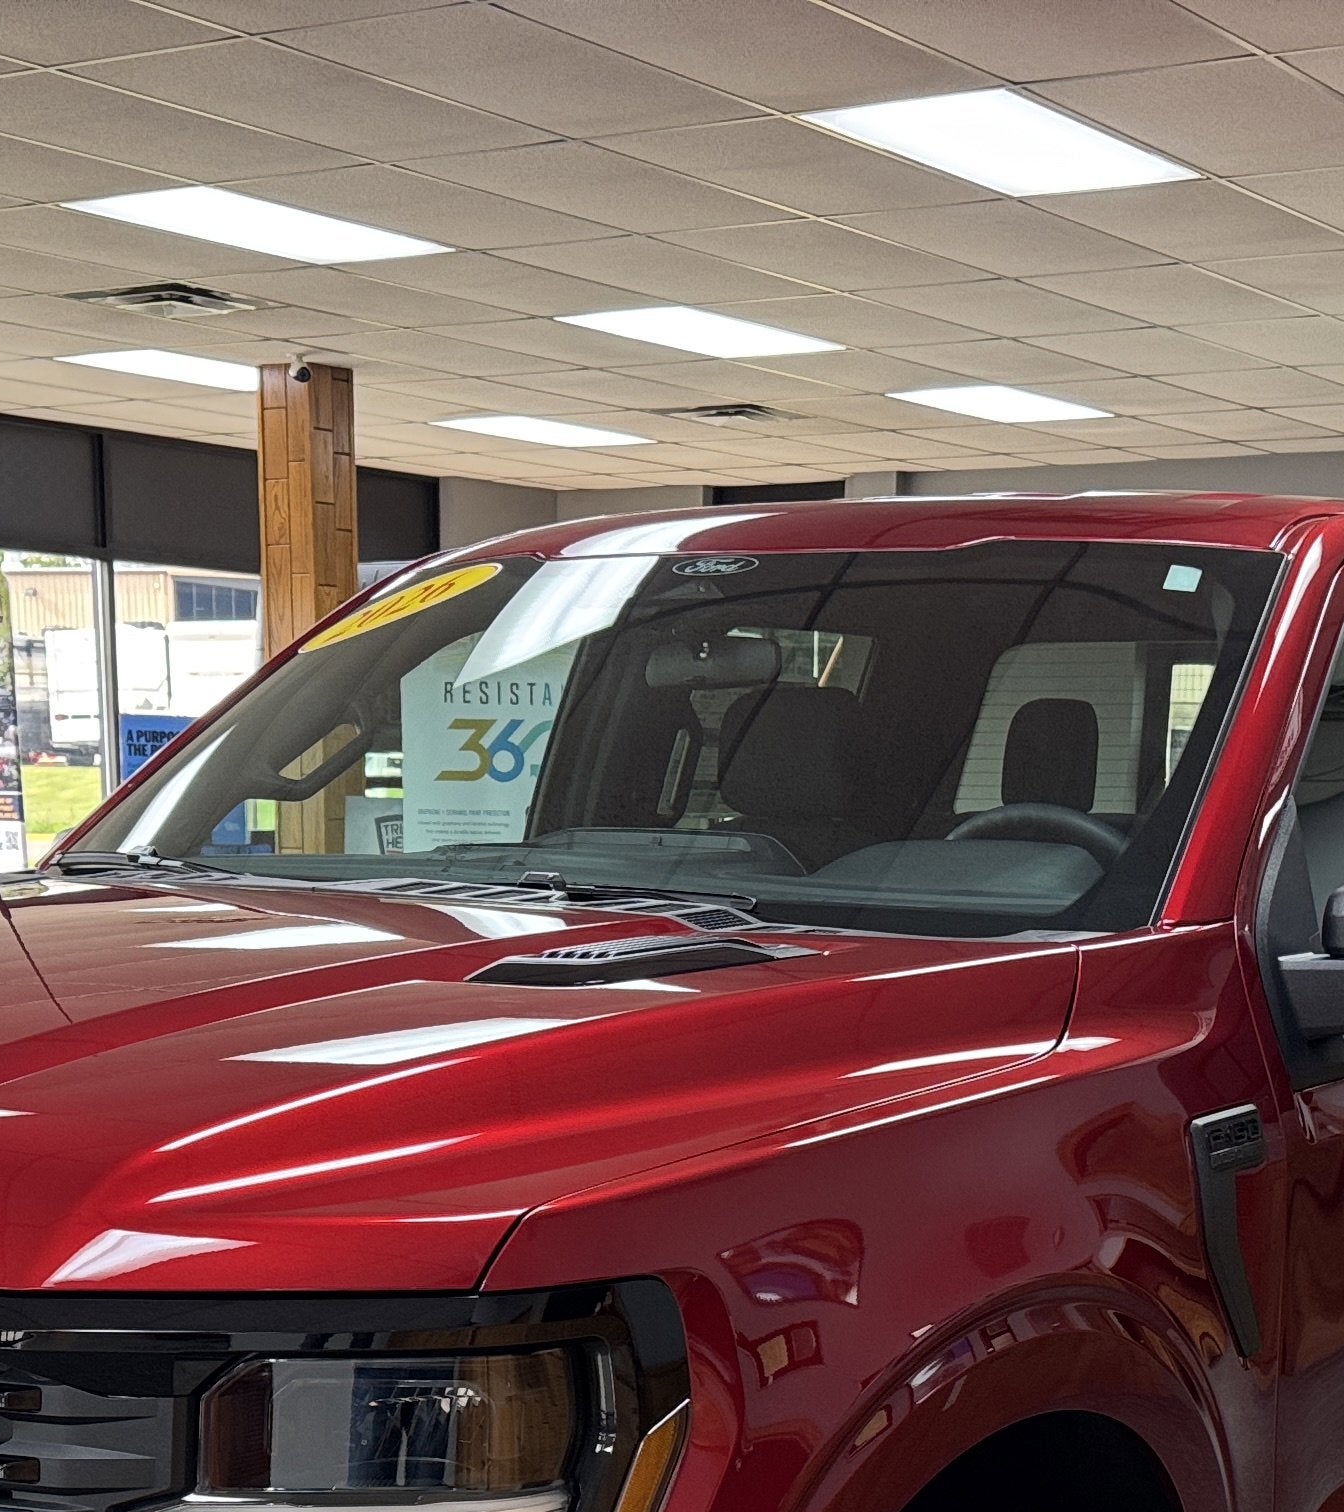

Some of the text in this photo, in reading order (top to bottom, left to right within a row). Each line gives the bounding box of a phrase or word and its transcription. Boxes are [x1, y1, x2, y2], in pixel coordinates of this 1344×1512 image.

[684, 558, 746, 573] Ford
[322, 572, 469, 643] 2026
[443, 681, 564, 706] RESISTA
[136, 730, 181, 744] PURPO
[127, 743, 149, 757] THE
